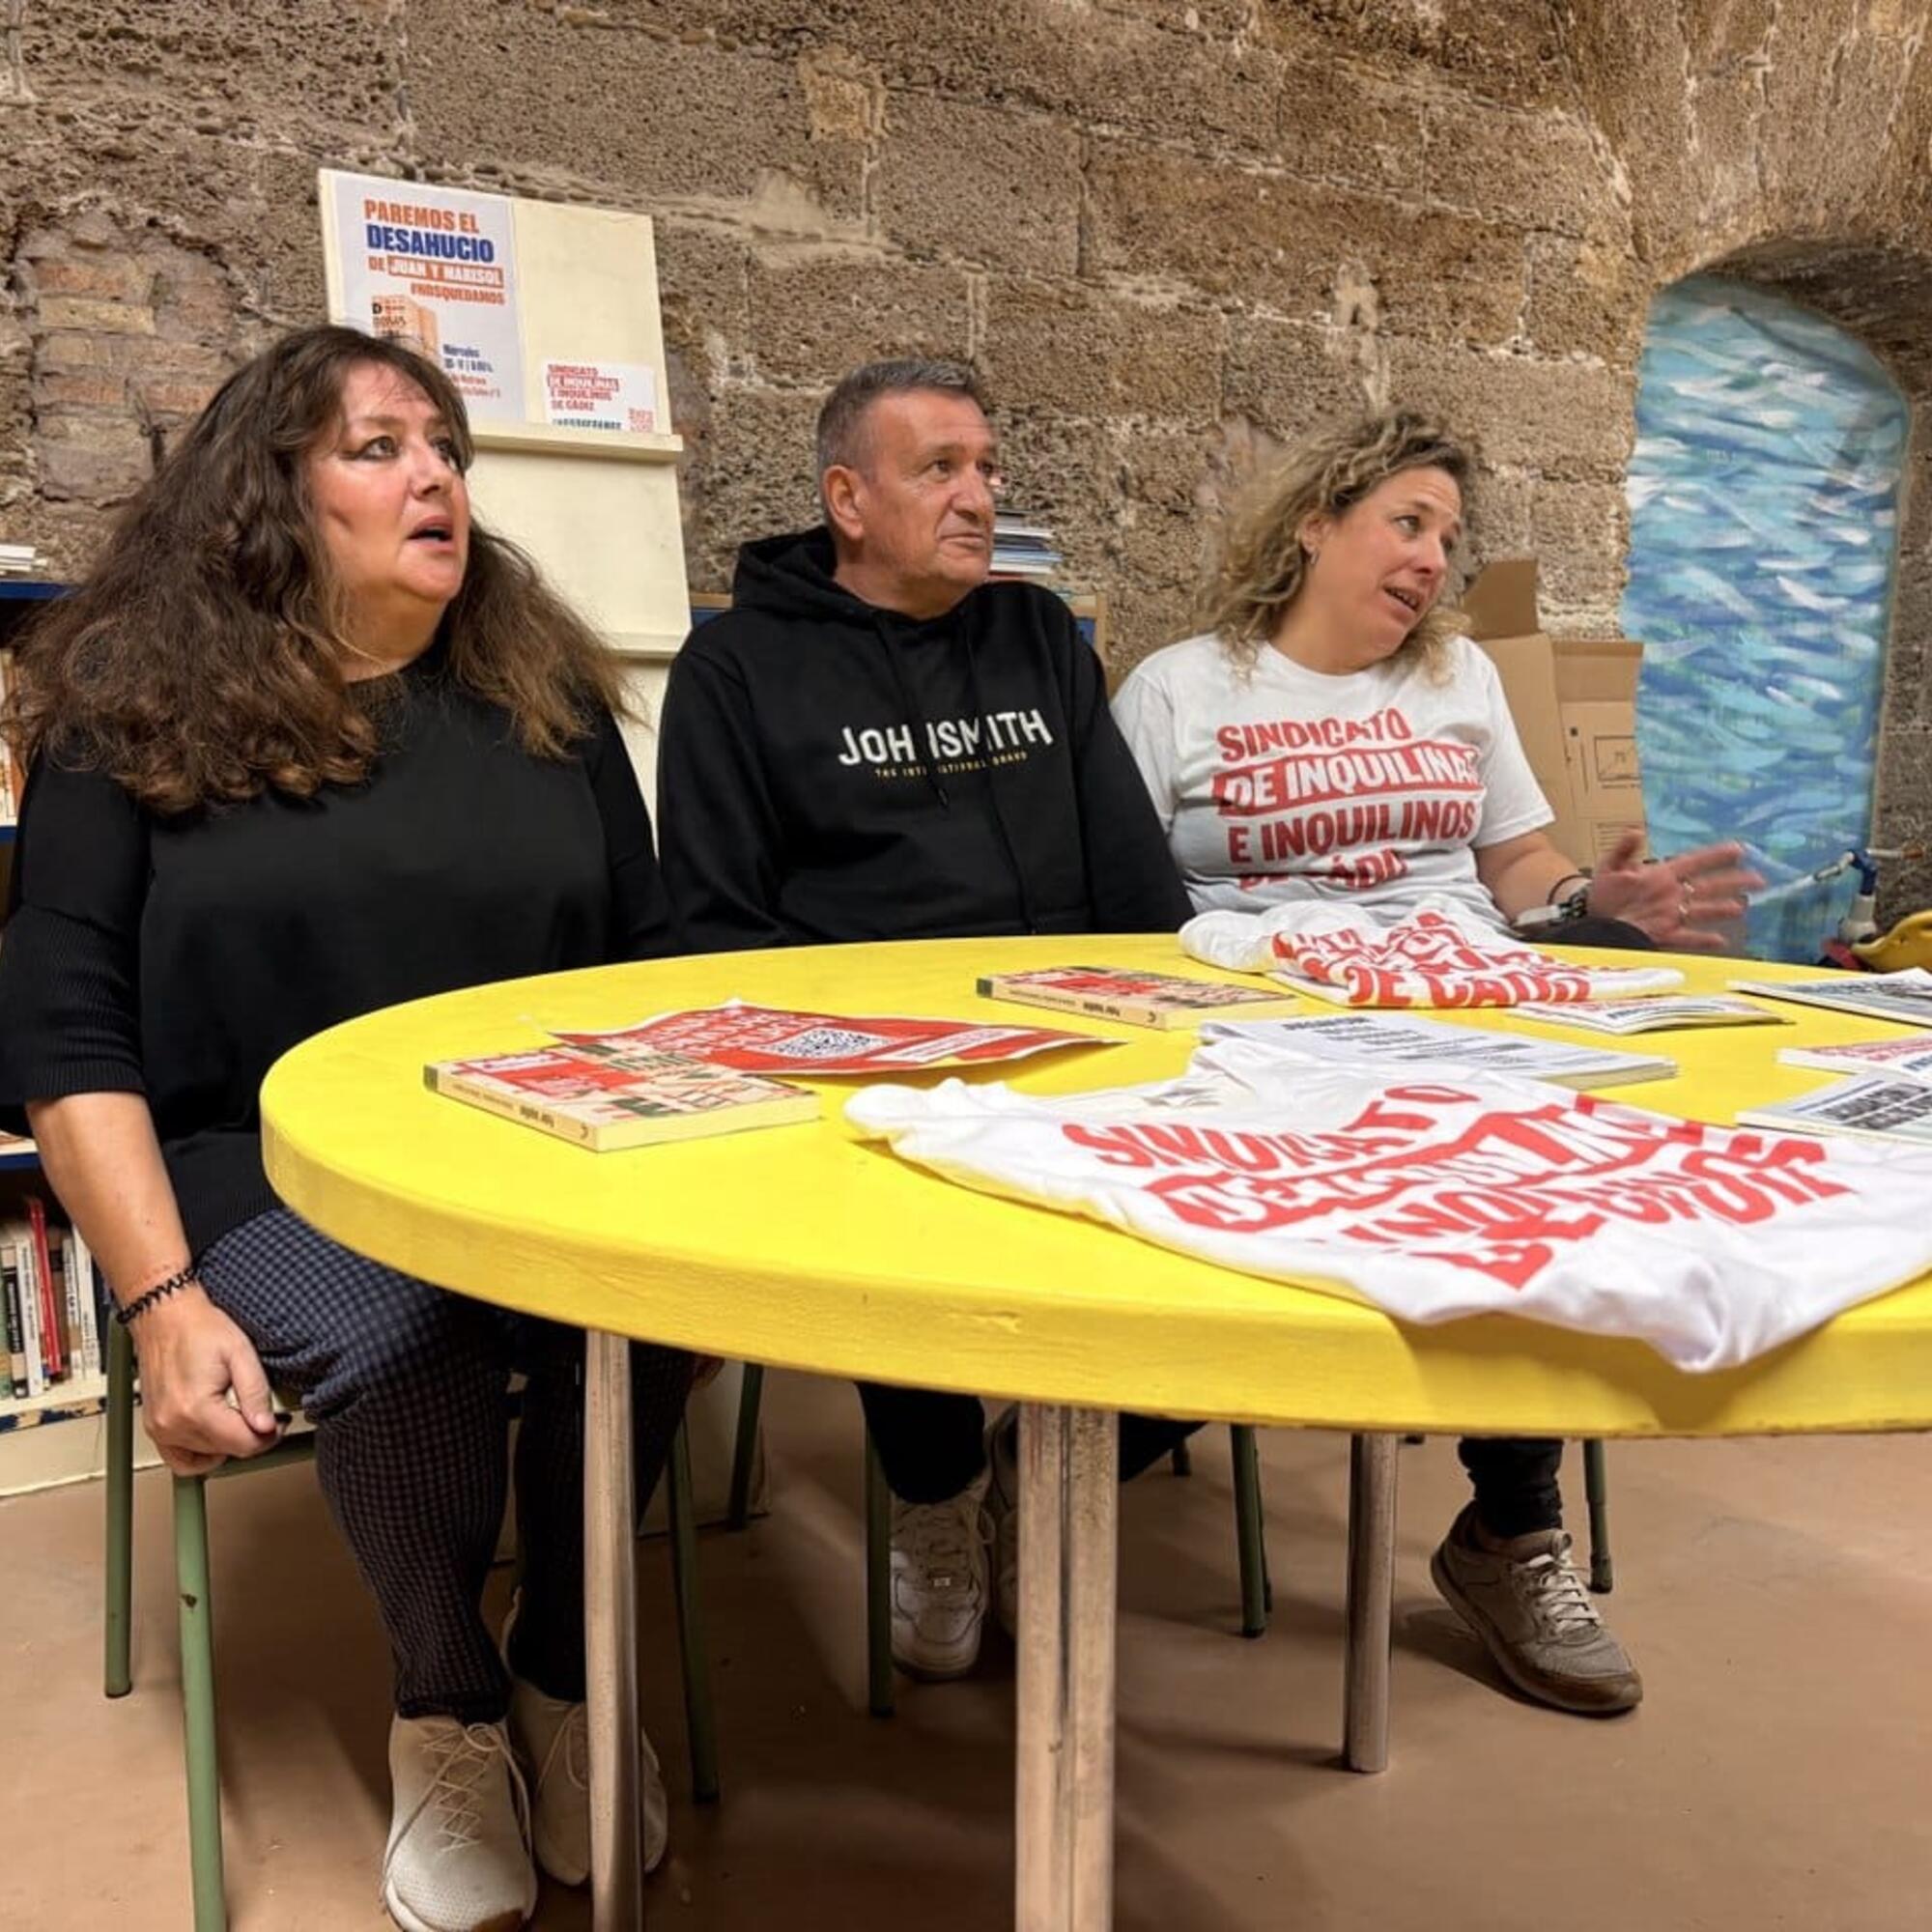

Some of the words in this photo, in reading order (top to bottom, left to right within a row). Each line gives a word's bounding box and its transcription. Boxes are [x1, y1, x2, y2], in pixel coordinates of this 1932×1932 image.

[364, 199, 455, 232] PAREMOS
[459, 212, 480, 234] EL
[366, 223, 495, 264] DESAHUCIO
[368, 256, 385, 271] DE
[1217, 707, 1412, 763] SINDICATO
[1223, 767, 1277, 809] DE
[1228, 826, 1252, 864] E
[1261, 800, 1476, 862] INQUILINOS
